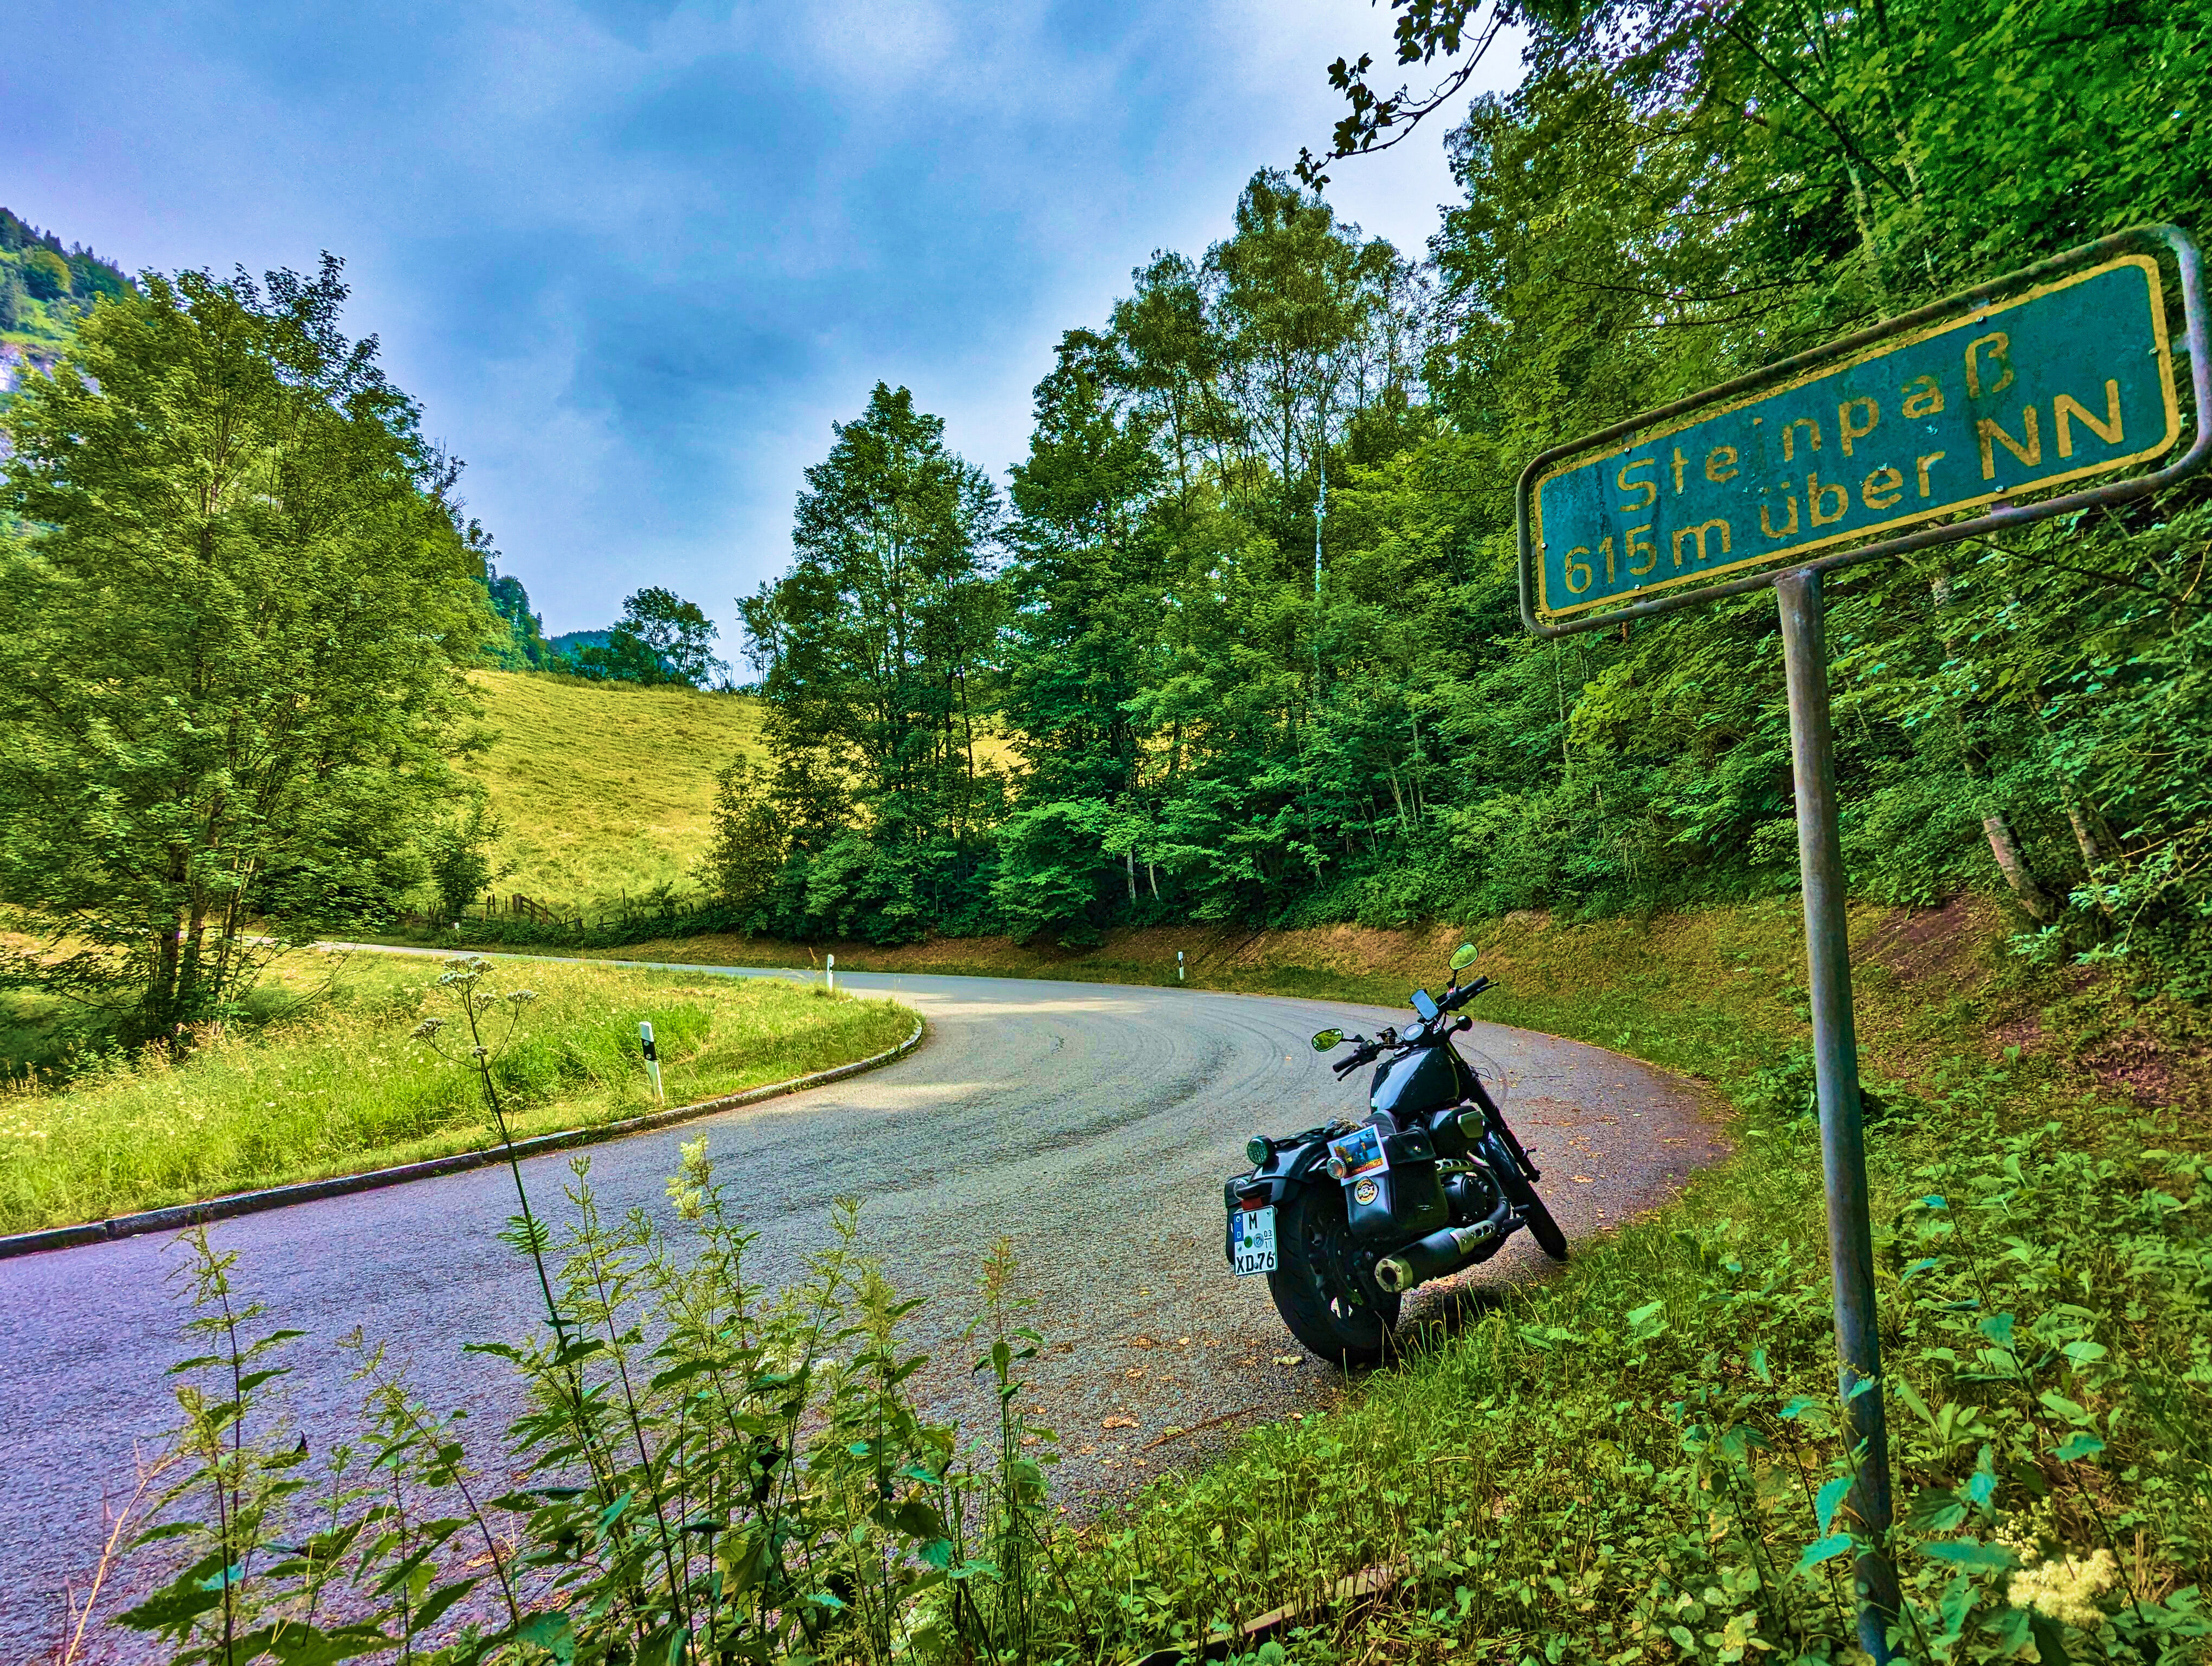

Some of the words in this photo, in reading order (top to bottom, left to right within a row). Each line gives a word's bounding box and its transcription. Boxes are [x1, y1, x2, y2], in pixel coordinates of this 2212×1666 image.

[1617, 331, 2014, 512] Stenpaß
[1758, 451, 1945, 538] über
[1976, 379, 2124, 480] NN
[1249, 1212, 1257, 1230] M
[1264, 1229, 1272, 1238] 03
[1265, 1240, 1272, 1248] 11
[1236, 1254, 1254, 1274] XD
[1257, 1251, 1275, 1270] 76
